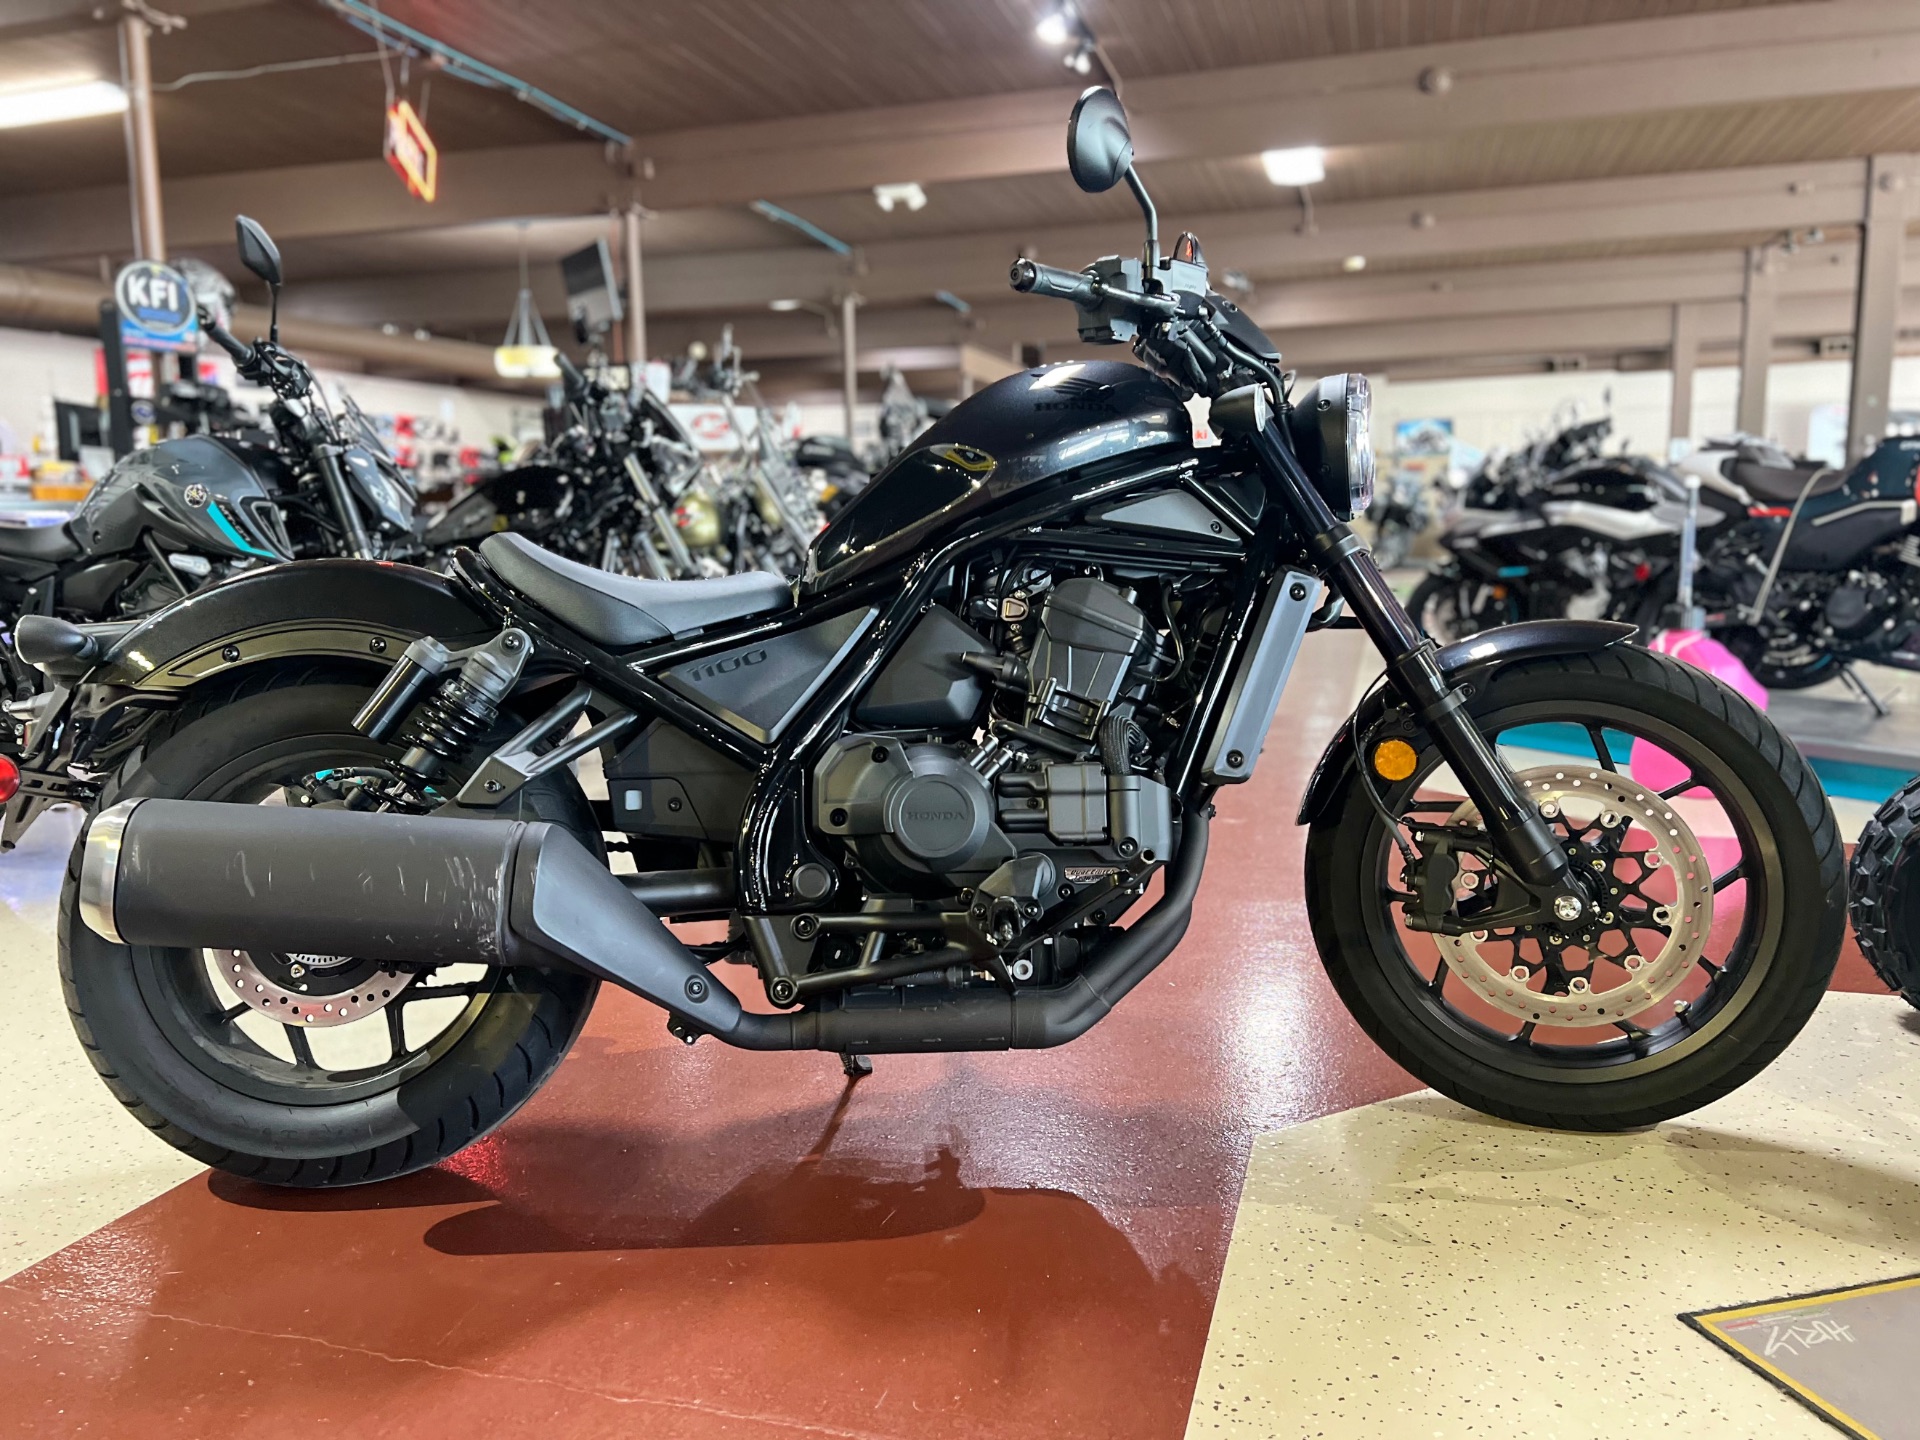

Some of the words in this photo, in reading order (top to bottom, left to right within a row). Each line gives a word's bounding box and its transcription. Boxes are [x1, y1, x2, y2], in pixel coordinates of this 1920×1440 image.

[127, 274, 179, 312] KFI
[1033, 402, 1121, 414] HONDA
[219, 504, 252, 541] MT-07
[687, 649, 767, 681] 1100
[907, 811, 965, 820] HONDA
